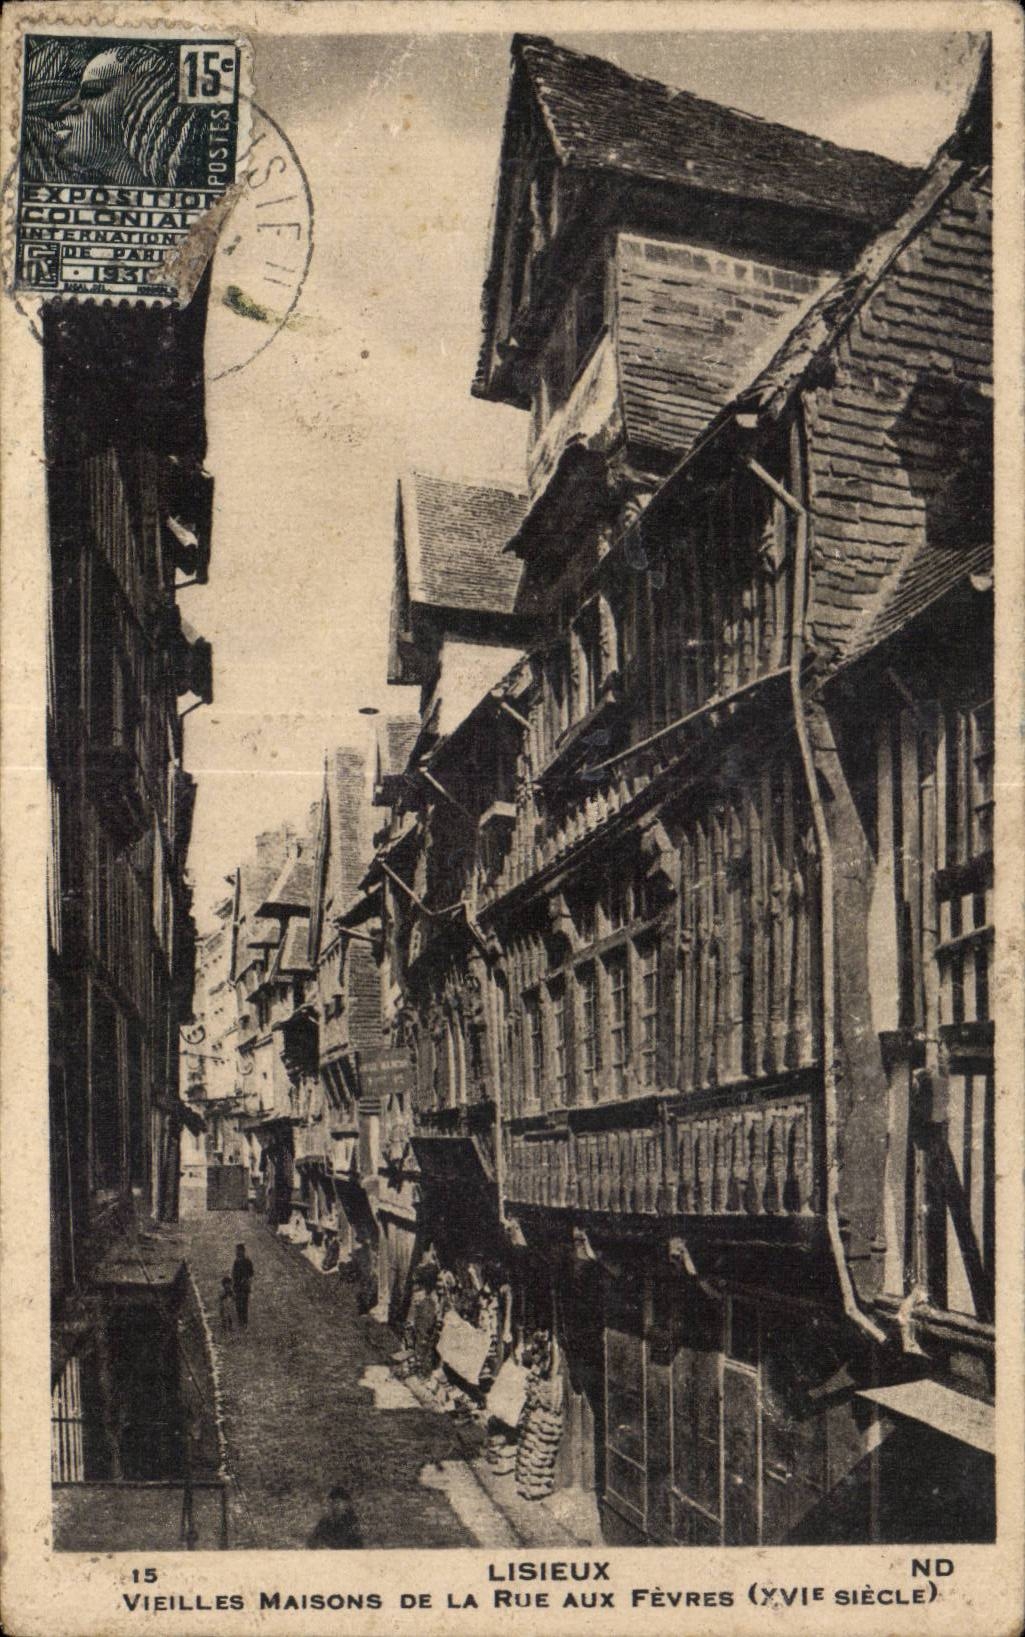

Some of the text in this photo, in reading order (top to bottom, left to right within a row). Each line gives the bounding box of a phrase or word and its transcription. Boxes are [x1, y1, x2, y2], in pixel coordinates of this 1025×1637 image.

[207, 109, 230, 186] POSTES
[24, 206, 193, 229] COLONIAL
[22, 228, 177, 245] INTERNATION
[63, 246, 165, 262] DE PARI
